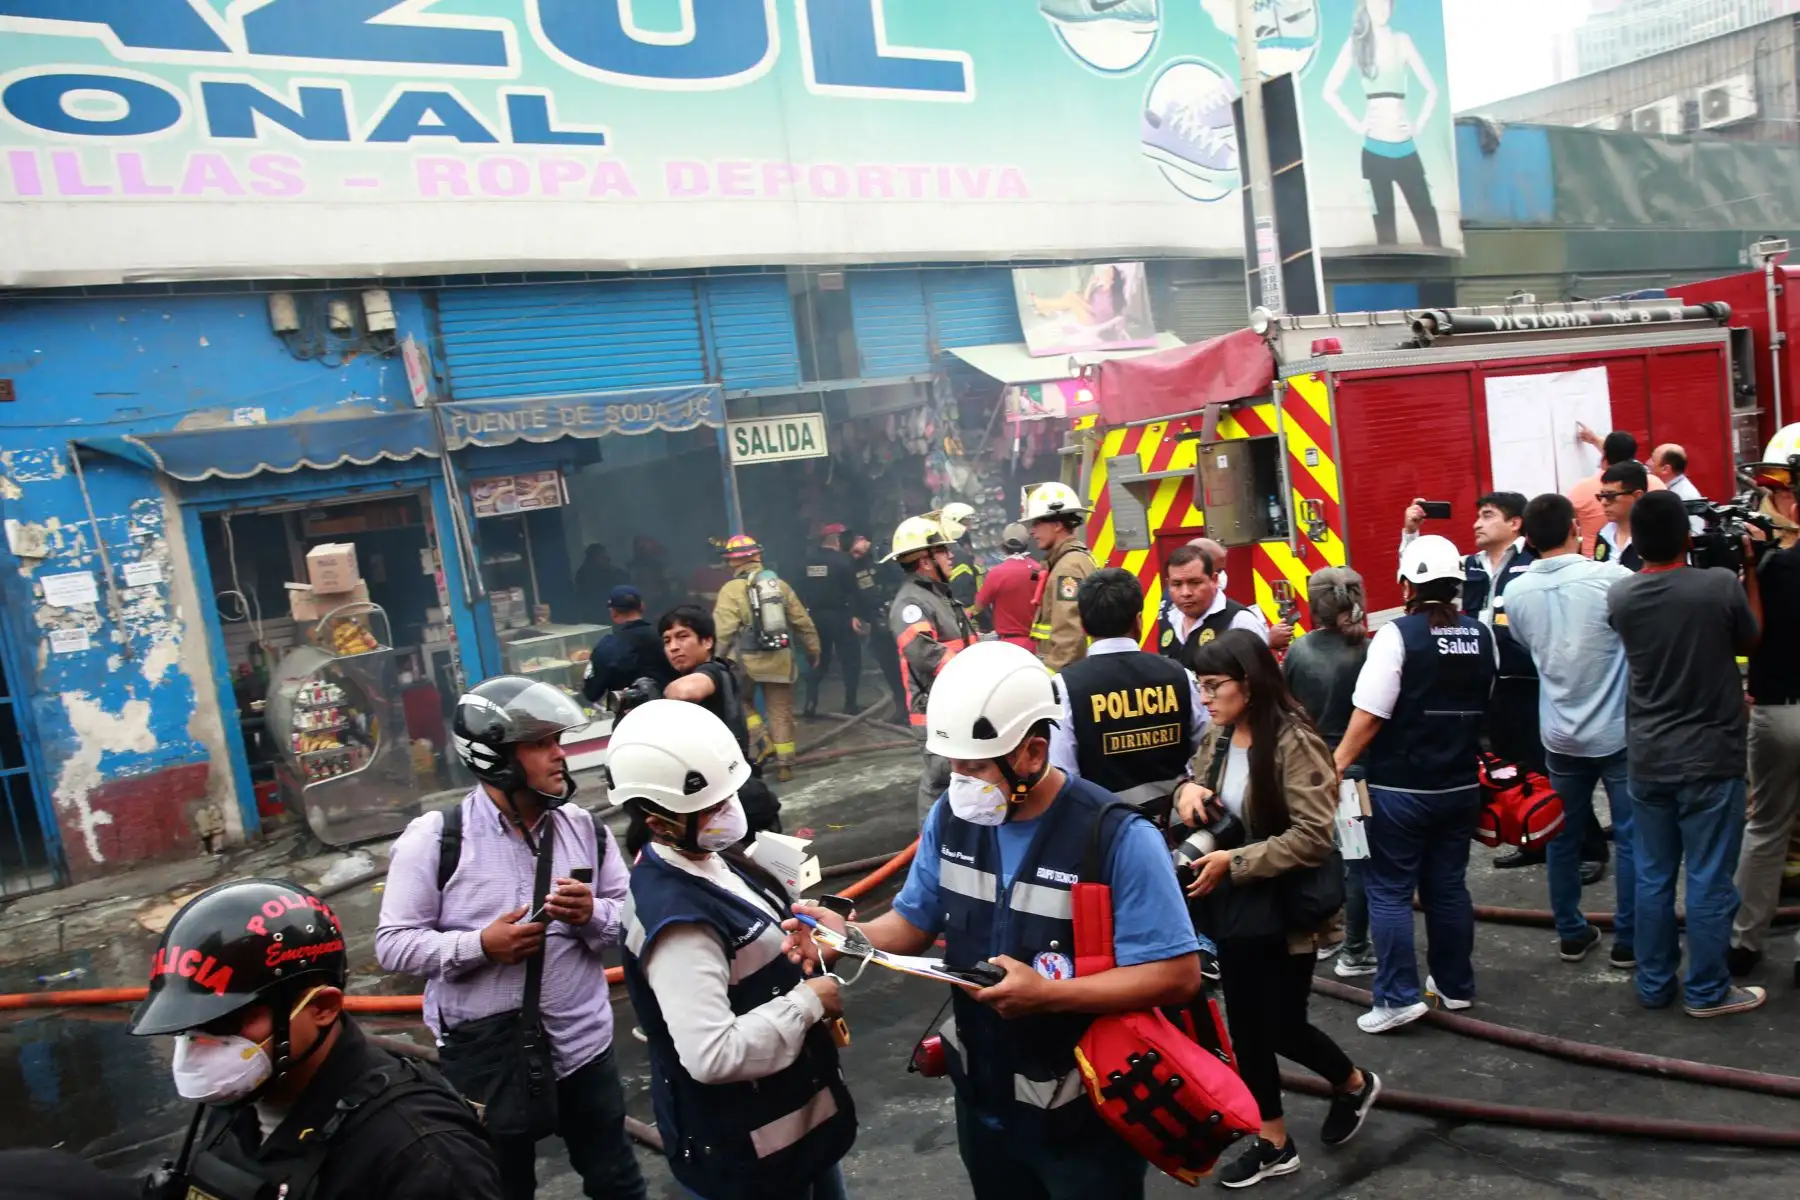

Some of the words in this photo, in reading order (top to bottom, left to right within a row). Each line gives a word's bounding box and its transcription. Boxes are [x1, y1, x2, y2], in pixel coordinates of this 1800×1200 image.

[3, 73, 605, 146] ONAL
[8, 151, 305, 196] ILLAS
[416, 157, 638, 198] ROPA
[665, 162, 1031, 198] DEPORTIVA
[1491, 312, 1591, 331] VICTORIA
[452, 406, 547, 434] FUENTE
[561, 405, 592, 426] DE
[605, 402, 667, 424] SODA
[735, 422, 815, 457] SALIDA
[1437, 637, 1480, 654] Salud
[1111, 728, 1174, 751] DIRINCRI
